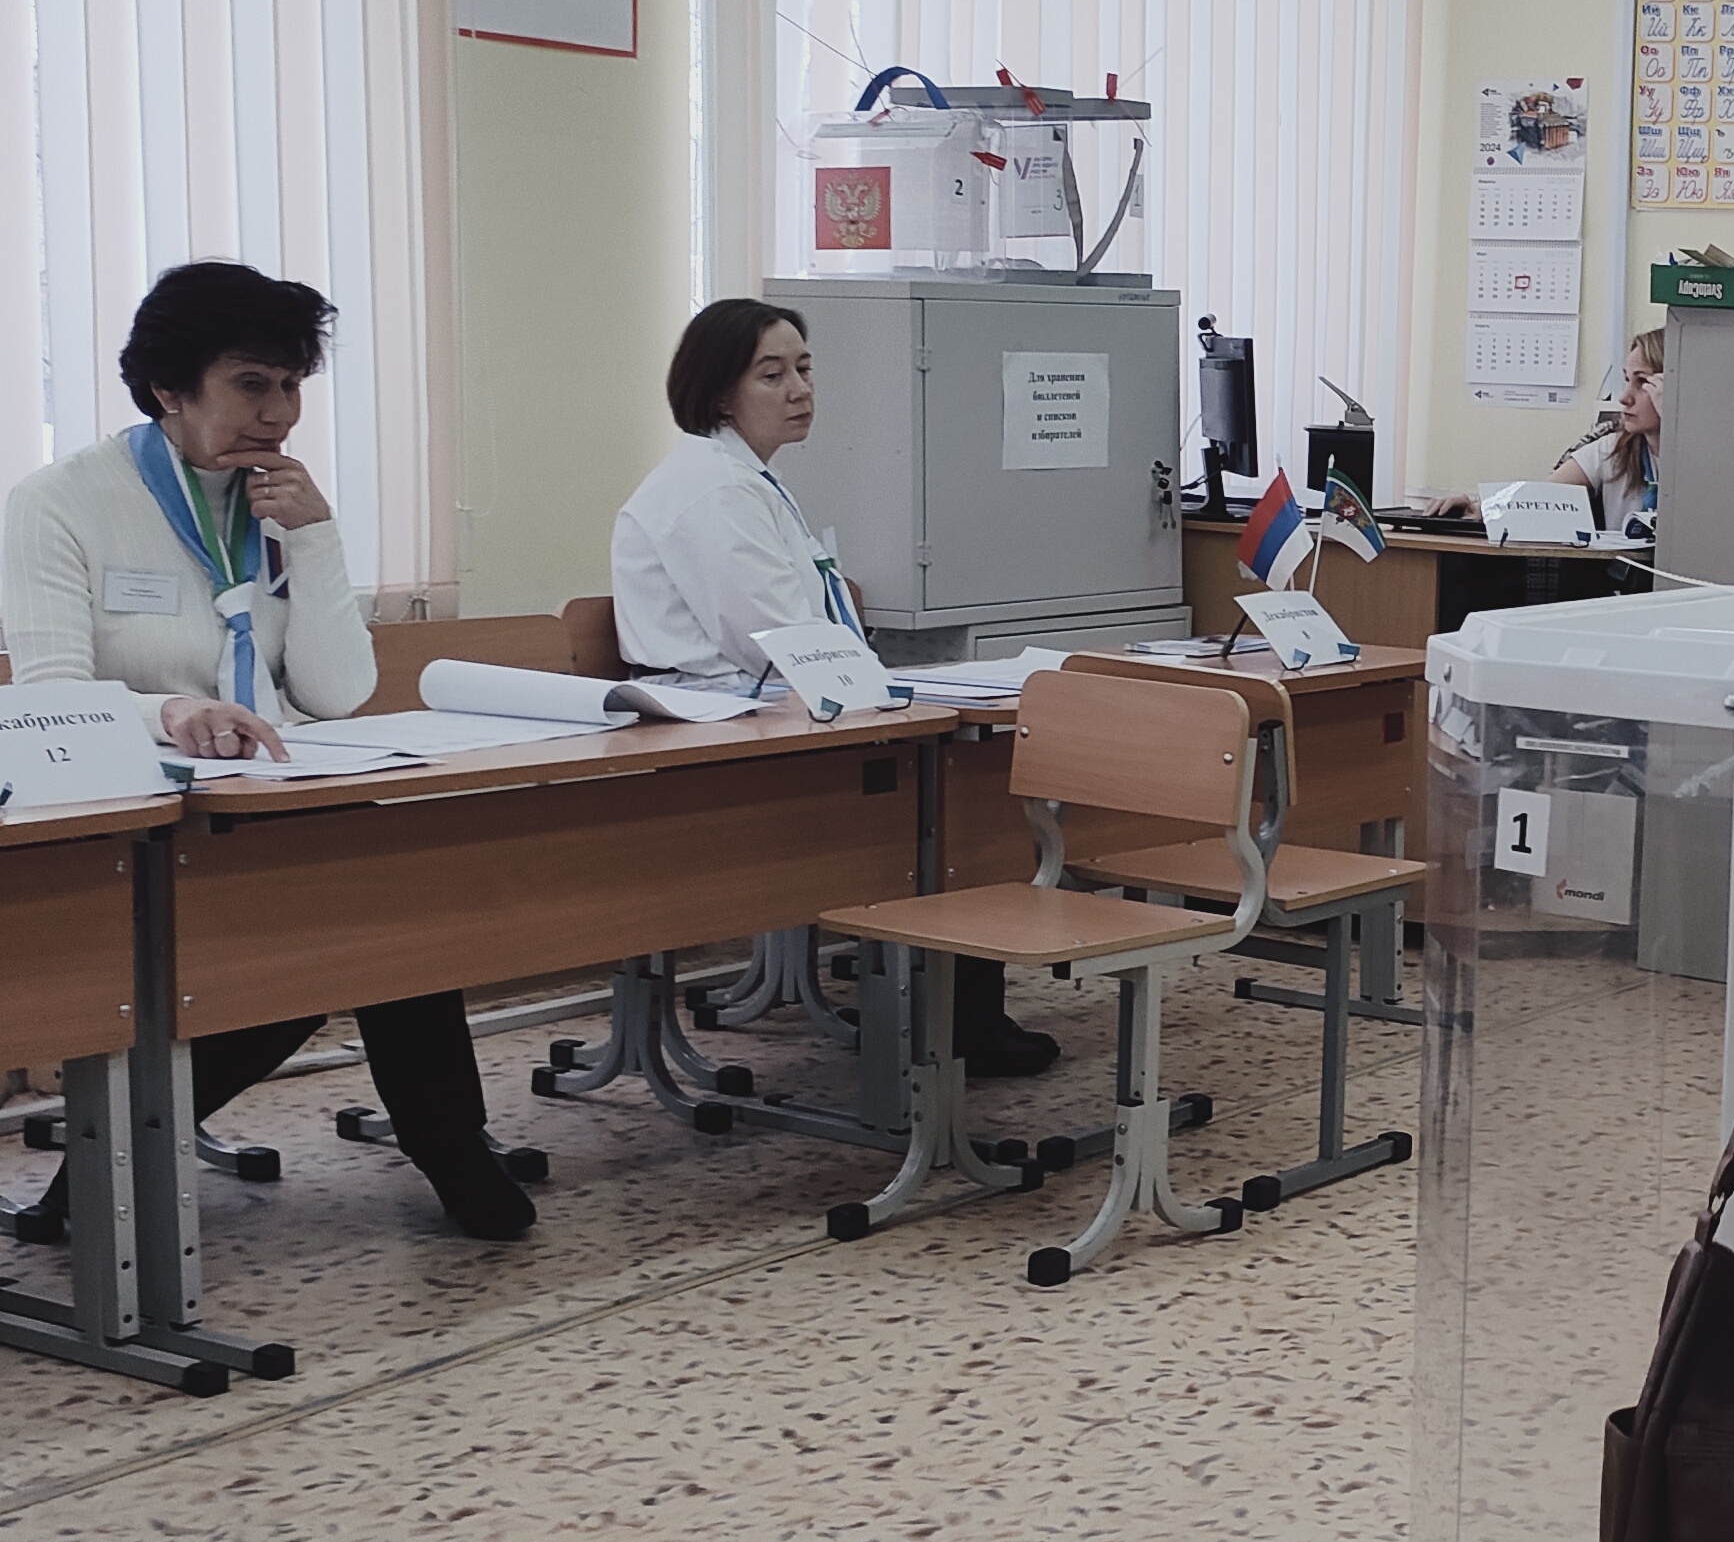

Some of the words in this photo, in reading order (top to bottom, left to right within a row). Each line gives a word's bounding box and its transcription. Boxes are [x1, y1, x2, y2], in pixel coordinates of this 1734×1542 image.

[1480, 143, 1501, 151] 2024
[955, 179, 963, 196] 2
[1678, 279, 1723, 300] SvetoCopy
[1028, 372, 1044, 383] Для
[1047, 374, 1085, 385] хранения
[1033, 390, 1080, 400] бюллетеней
[1045, 413, 1076, 421] списков
[1032, 429, 1081, 442] избирателей
[1496, 500, 1579, 513] ЕКРЕТАРЬ
[1261, 609, 1318, 623] Декабристов
[788, 649, 861, 667] Декабристов
[838, 675, 854, 686] 10
[46, 747, 71, 763] 12
[1511, 813, 1532, 854] 1
[1564, 888, 1605, 901] mondi
